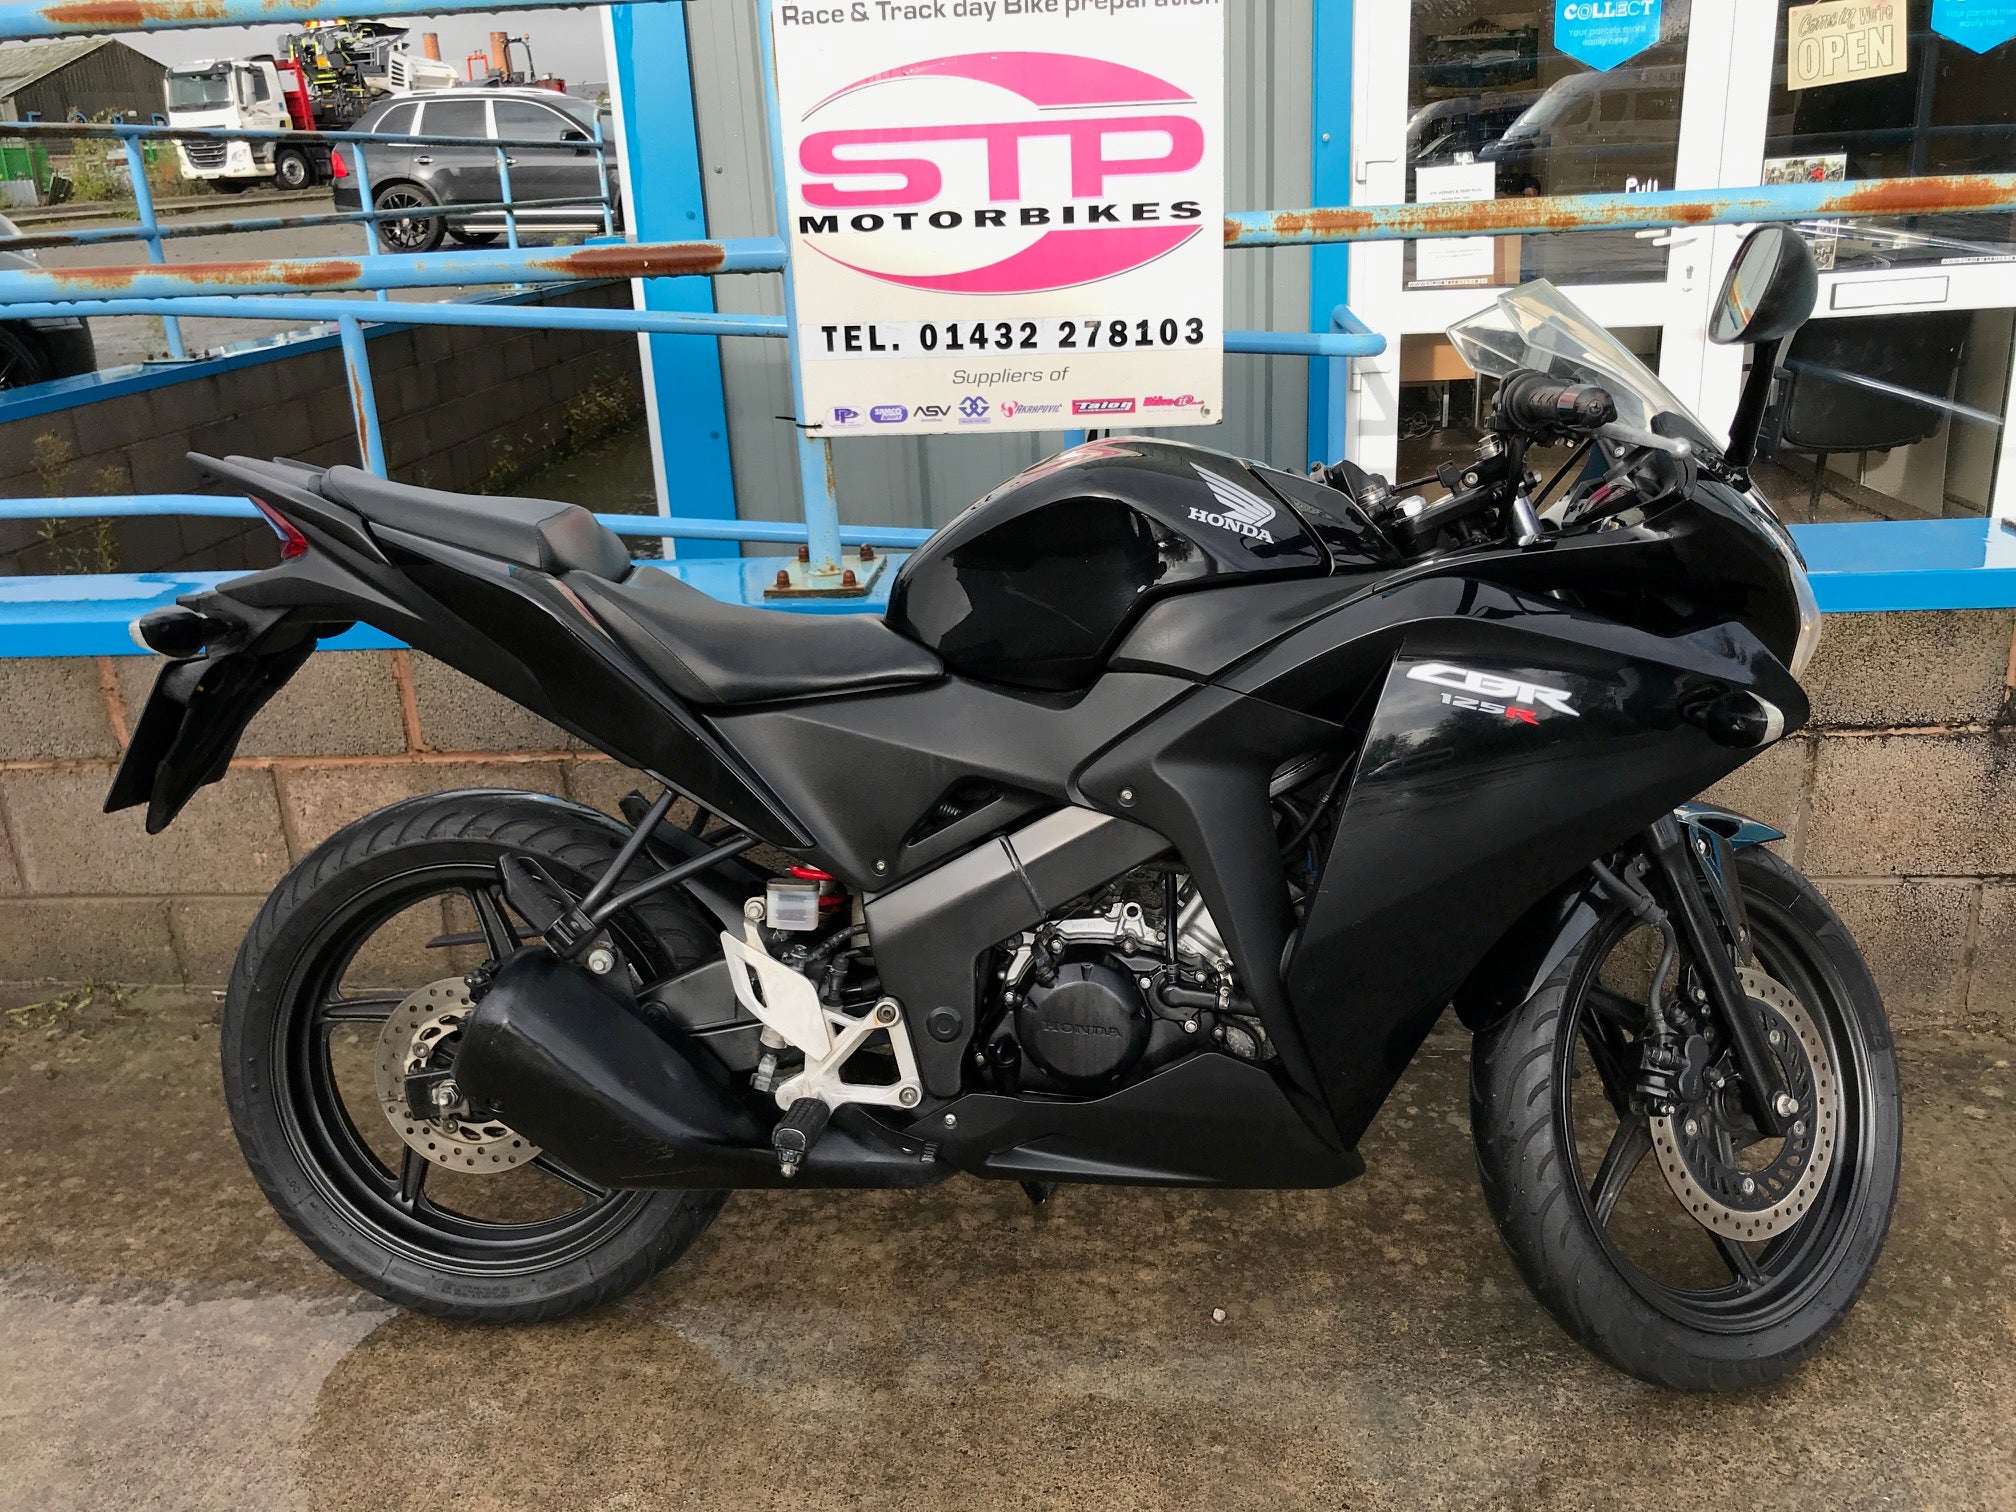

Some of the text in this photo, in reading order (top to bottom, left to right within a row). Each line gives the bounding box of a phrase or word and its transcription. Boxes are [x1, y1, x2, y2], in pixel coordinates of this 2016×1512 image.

[782, 6, 844, 25] Race
[851, 2, 869, 22] &
[875, 0, 946, 21] Track
[953, 0, 996, 22] day
[1004, 0, 1058, 14] Bike
[1564, 0, 1655, 20] COLLECT
[1798, 13, 1836, 37] Come
[1859, 4, 1893, 25] We're
[1569, 25, 1646, 37] Your parcels more
[1797, 25, 1894, 81] OPEN
[800, 115, 1204, 207] STP
[1626, 177, 1658, 193] Pull
[800, 201, 1203, 234] MOTORBIKES
[822, 317, 1204, 352] TEL. 01432 278103
[952, 365, 1069, 387] Suppliers of
[913, 405, 951, 417] ASV
[1188, 507, 1274, 544] HONDA
[1406, 662, 1580, 717] CBR
[1440, 692, 1540, 726] 125R
[1042, 1021, 1121, 1038] HONDA
